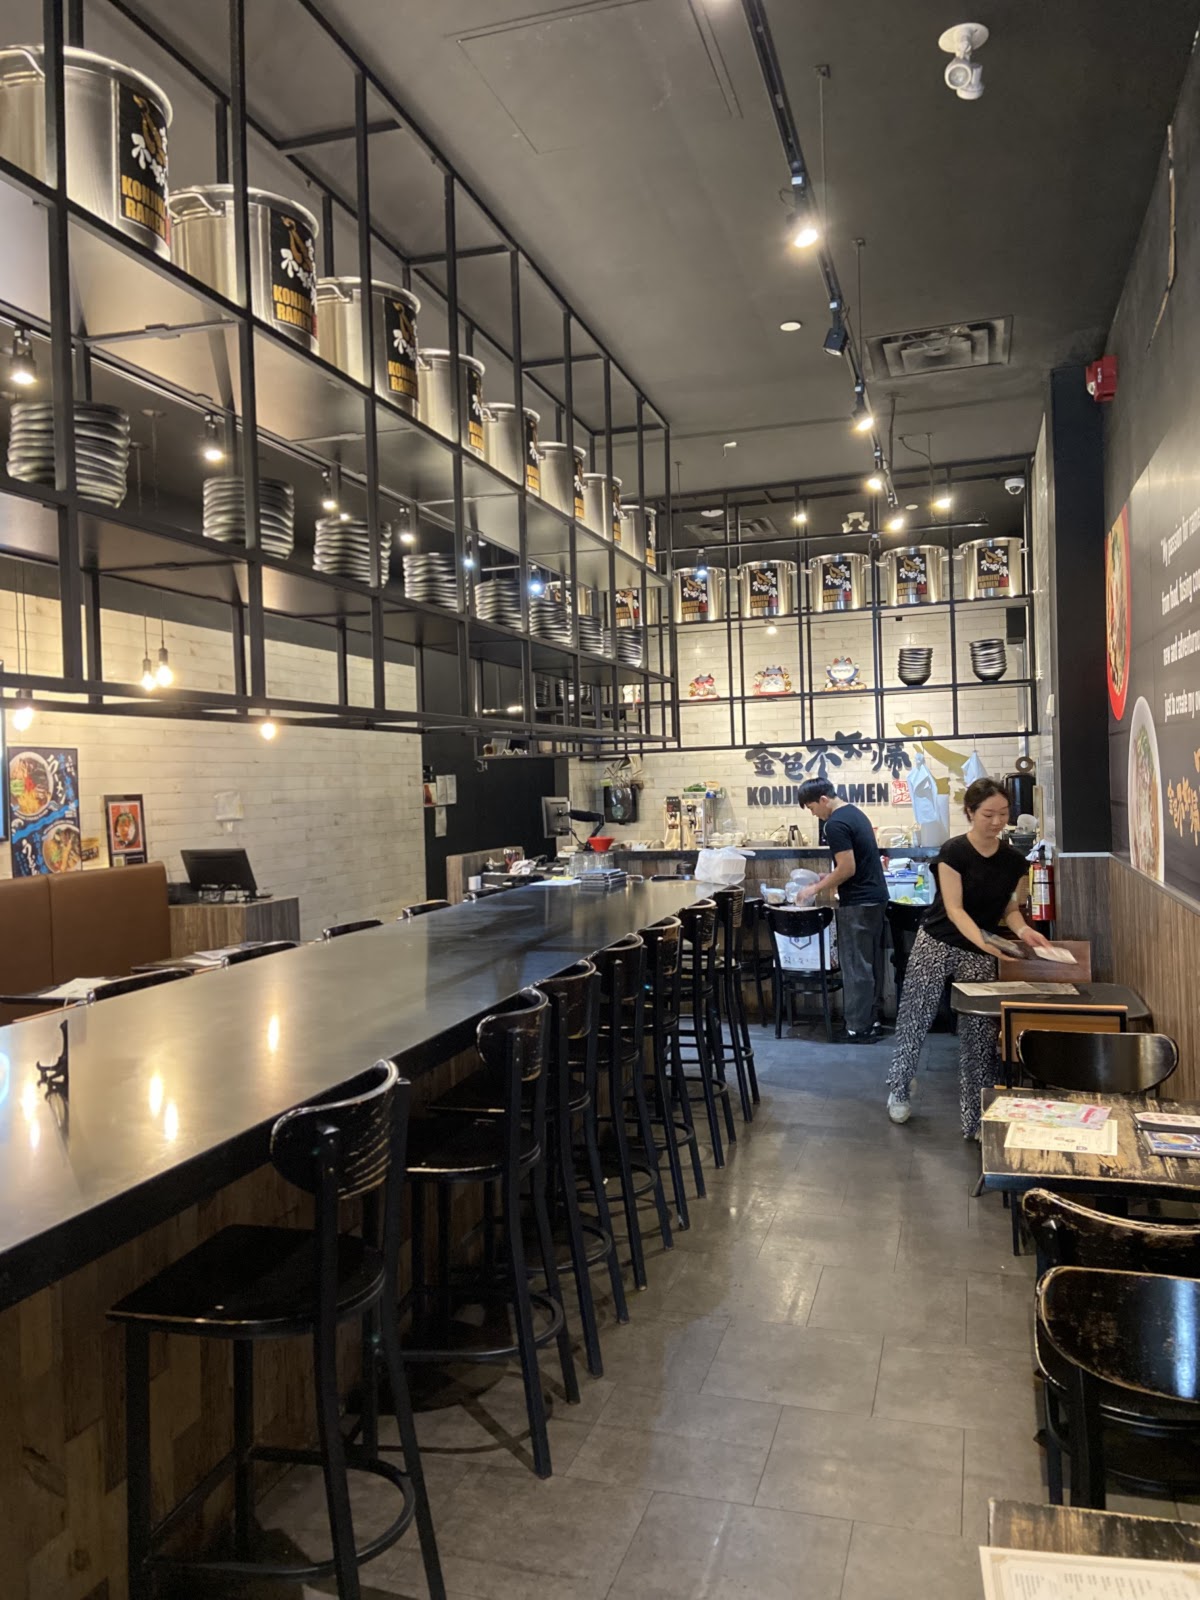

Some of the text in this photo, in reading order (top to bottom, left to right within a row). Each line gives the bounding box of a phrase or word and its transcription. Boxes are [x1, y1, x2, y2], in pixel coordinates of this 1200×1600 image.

[1170, 635, 1178, 663] and
[746, 785, 799, 806] KONJI
[836, 783, 889, 804] AMEN
